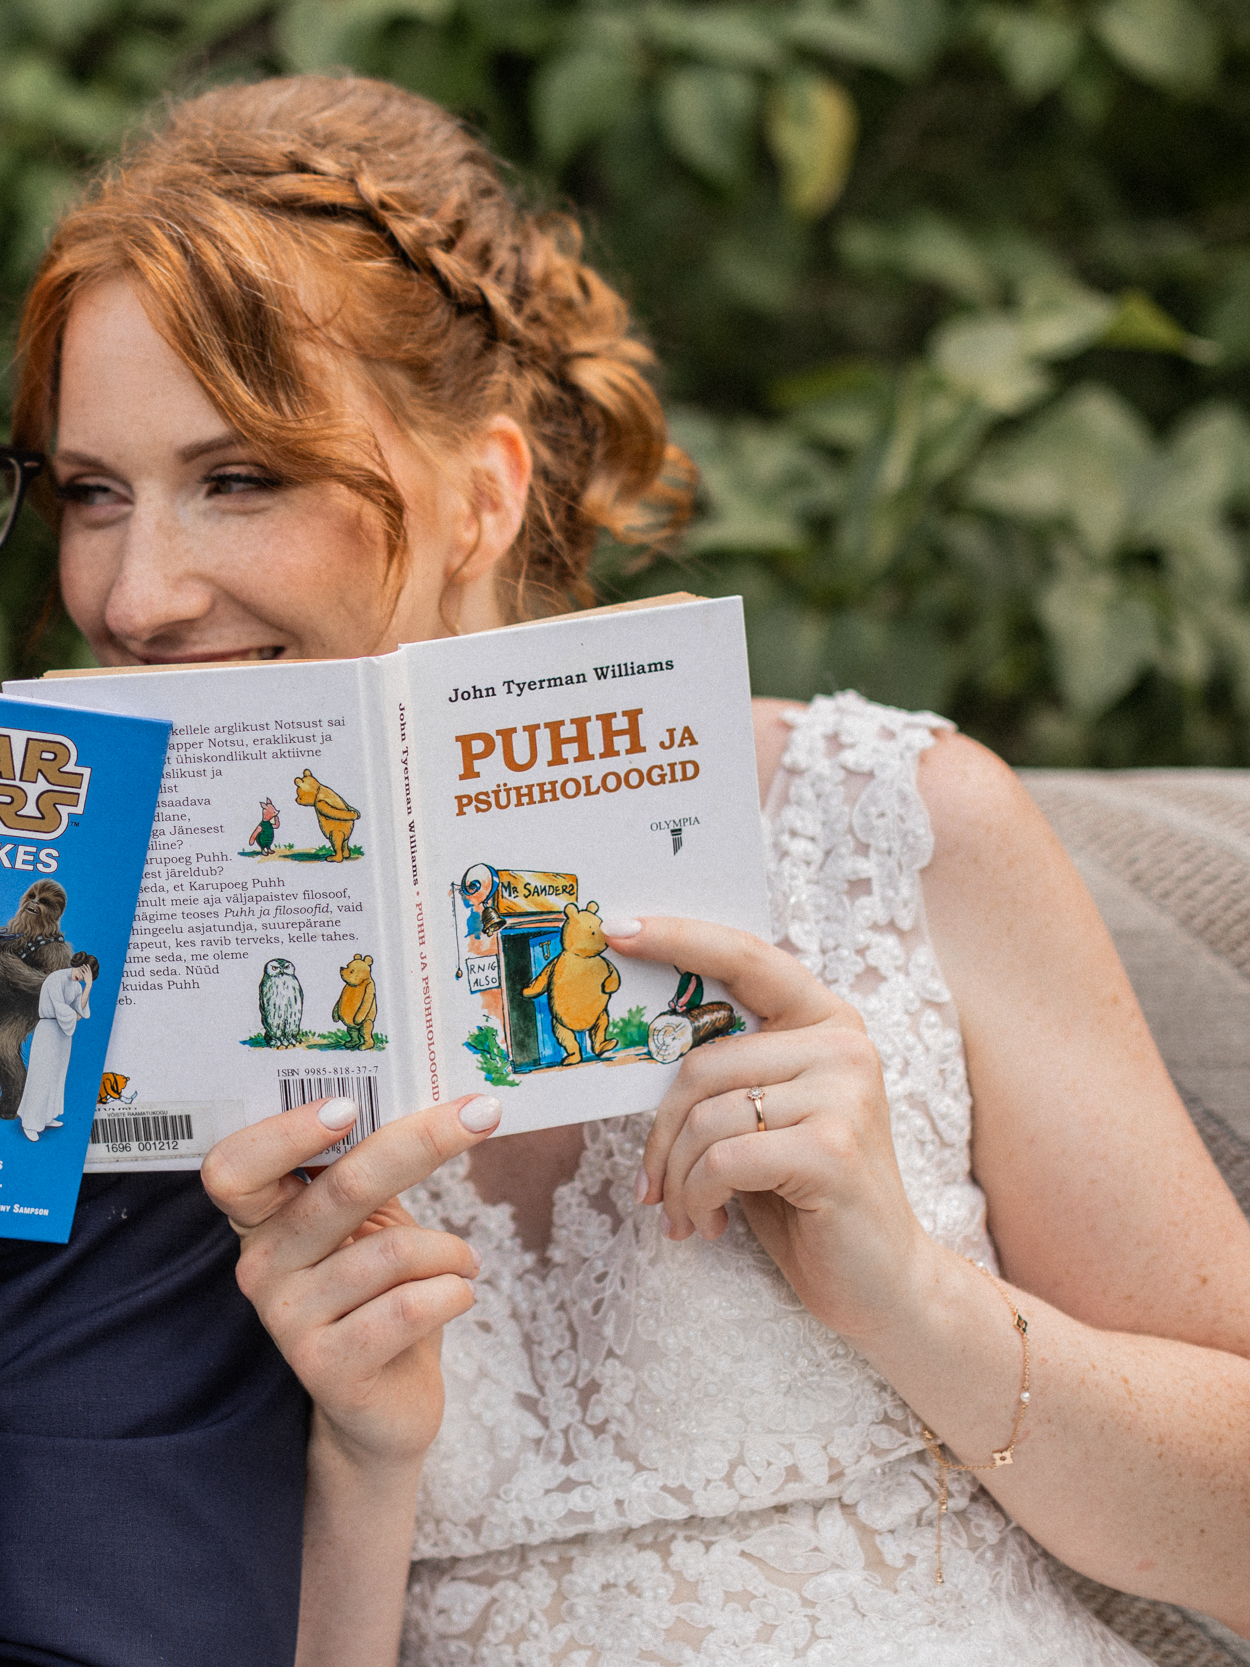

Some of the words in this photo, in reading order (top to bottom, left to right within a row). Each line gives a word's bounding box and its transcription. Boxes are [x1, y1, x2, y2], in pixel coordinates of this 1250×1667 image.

[448, 685, 496, 702] John
[502, 673, 587, 696] Tyerman
[593, 660, 673, 680] Williams
[171, 724, 209, 735] kellele
[214, 721, 269, 735] arglikust
[274, 719, 322, 730] Notsust
[327, 716, 345, 727] sai
[399, 703, 407, 742] John
[208, 738, 248, 747] Notsu,
[252, 733, 316, 745] eraklikust
[319, 732, 332, 744] ja
[455, 707, 646, 780] PUHH
[659, 725, 698, 749] JA
[175, 749, 266, 764] ühiskondlikult
[271, 747, 321, 758] aktiivne
[210, 766, 222, 779] ja
[402, 746, 412, 816] Tyerman
[454, 759, 699, 816] PSÜHHOLOOGID
[169, 824, 223, 835] Jänesest
[650, 816, 700, 831] OLYMPIA
[195, 851, 231, 862] Puhh.
[408, 819, 420, 886] Williams
[165, 865, 223, 880] järeldub?
[173, 883, 184, 891] et
[189, 881, 248, 892] Karupoeg
[252, 877, 285, 887] Puhh
[170, 895, 198, 905] meie
[203, 894, 221, 907] aja
[225, 891, 298, 905] väljapaistev
[302, 887, 350, 899] filosoof,
[133, 911, 176, 923] nägime
[181, 910, 219, 919] teoses
[224, 906, 254, 917] Puhh
[257, 906, 270, 918] ja
[273, 903, 332, 917] filosoofid,
[336, 901, 362, 912] vaid
[131, 924, 183, 937] hingeelu
[187, 921, 256, 934] asjatundja,
[261, 918, 340, 930] suurepärane
[416, 902, 426, 947] PUHH
[175, 938, 196, 947] kes
[200, 936, 231, 946] ravib
[235, 934, 283, 945] terveks,
[288, 932, 316, 942] kelle
[321, 931, 358, 941] tahes.
[154, 952, 186, 962] seda,
[213, 950, 248, 960] oleme
[420, 951, 428, 972] JA
[149, 967, 180, 976] seda.
[185, 964, 219, 975] Nüüd
[121, 980, 163, 991] kuidas
[167, 979, 199, 989] Puhh
[422, 975, 440, 1102] PSÜHHOLOOGID
[277, 1068, 300, 1077] ISBN
[304, 1066, 379, 1076] 9985-818-37-7
[105, 1142, 132, 1153] 1696
[138, 1140, 179, 1151] 001212
